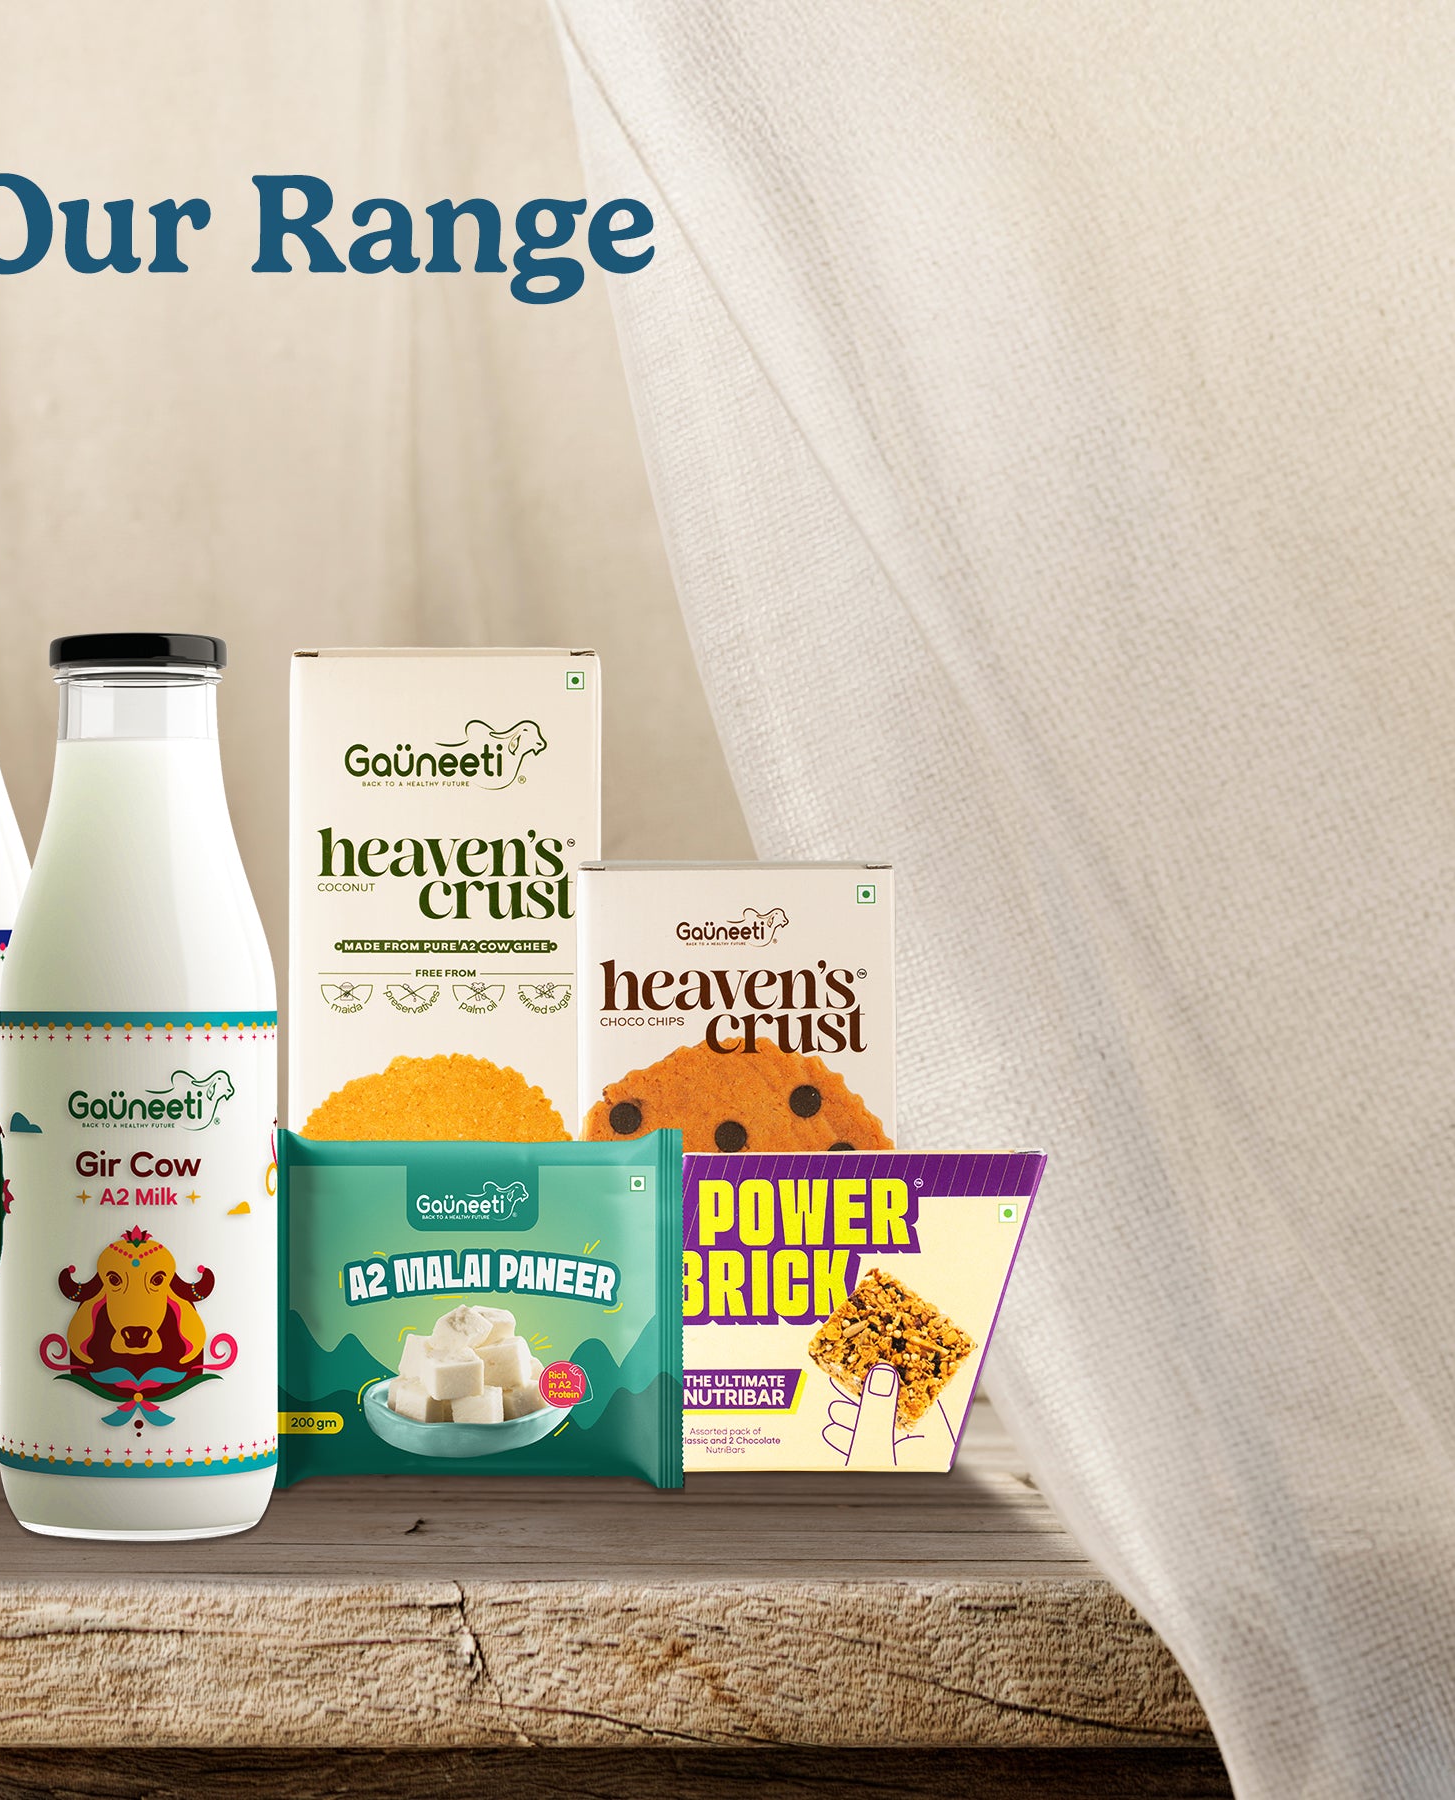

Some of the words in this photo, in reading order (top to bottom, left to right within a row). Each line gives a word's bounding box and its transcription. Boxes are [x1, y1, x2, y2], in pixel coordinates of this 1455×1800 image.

[344, 743, 503, 777] Gaüneeti
[317, 883, 376, 892] COCONUT
[419, 872, 576, 920] crust
[676, 921, 764, 940] Gaüneeti
[344, 942, 380, 951] MADE
[384, 942, 419, 951] FROM
[424, 942, 457, 951] PURE
[460, 942, 476, 951] A2
[479, 942, 511, 951] COW
[513, 942, 548, 951] GHEE
[415, 969, 443, 977] FREE
[445, 969, 477, 977] FROM
[330, 1003, 363, 1014] maida
[383, 989, 440, 1014] preservatives
[458, 1002, 486, 1015] palm
[486, 999, 498, 1012] oil
[517, 990, 548, 1015] refined
[549, 990, 572, 1013] sugar
[600, 1016, 645, 1027] CHOCO
[647, 1016, 685, 1027] CHIPS
[705, 1003, 868, 1054] crust
[68, 1090, 203, 1120] Gaüneeti
[75, 1150, 121, 1178] Gir
[130, 1151, 202, 1178] Cow
[99, 1188, 130, 1206] A2
[135, 1187, 178, 1206] Milk
[416, 1194, 505, 1214] Gaüneeti
[698, 1178, 911, 1246] POWER
[348, 1263, 388, 1301] A2
[393, 1254, 491, 1293] MALAI
[498, 1254, 616, 1301] PANEER
[683, 1249, 850, 1317] BRICK
[548, 1370, 568, 1379] Rich
[683, 1375, 712, 1388] THE
[714, 1375, 786, 1388] ULTIMATE
[548, 1380, 557, 1389] in
[558, 1380, 572, 1389] A2
[548, 1390, 580, 1399] Protein
[683, 1388, 785, 1406] NUTRIBAR
[291, 1417, 315, 1428] 200
[316, 1420, 337, 1431] gm
[689, 1427, 728, 1435] Assorted
[729, 1427, 751, 1437] pack
[752, 1426, 762, 1435] of
[683, 1436, 709, 1445] lassic
[709, 1437, 727, 1445] and
[728, 1437, 735, 1445] 2
[736, 1436, 781, 1445] Chocolate
[705, 1446, 746, 1454] NutriBars
